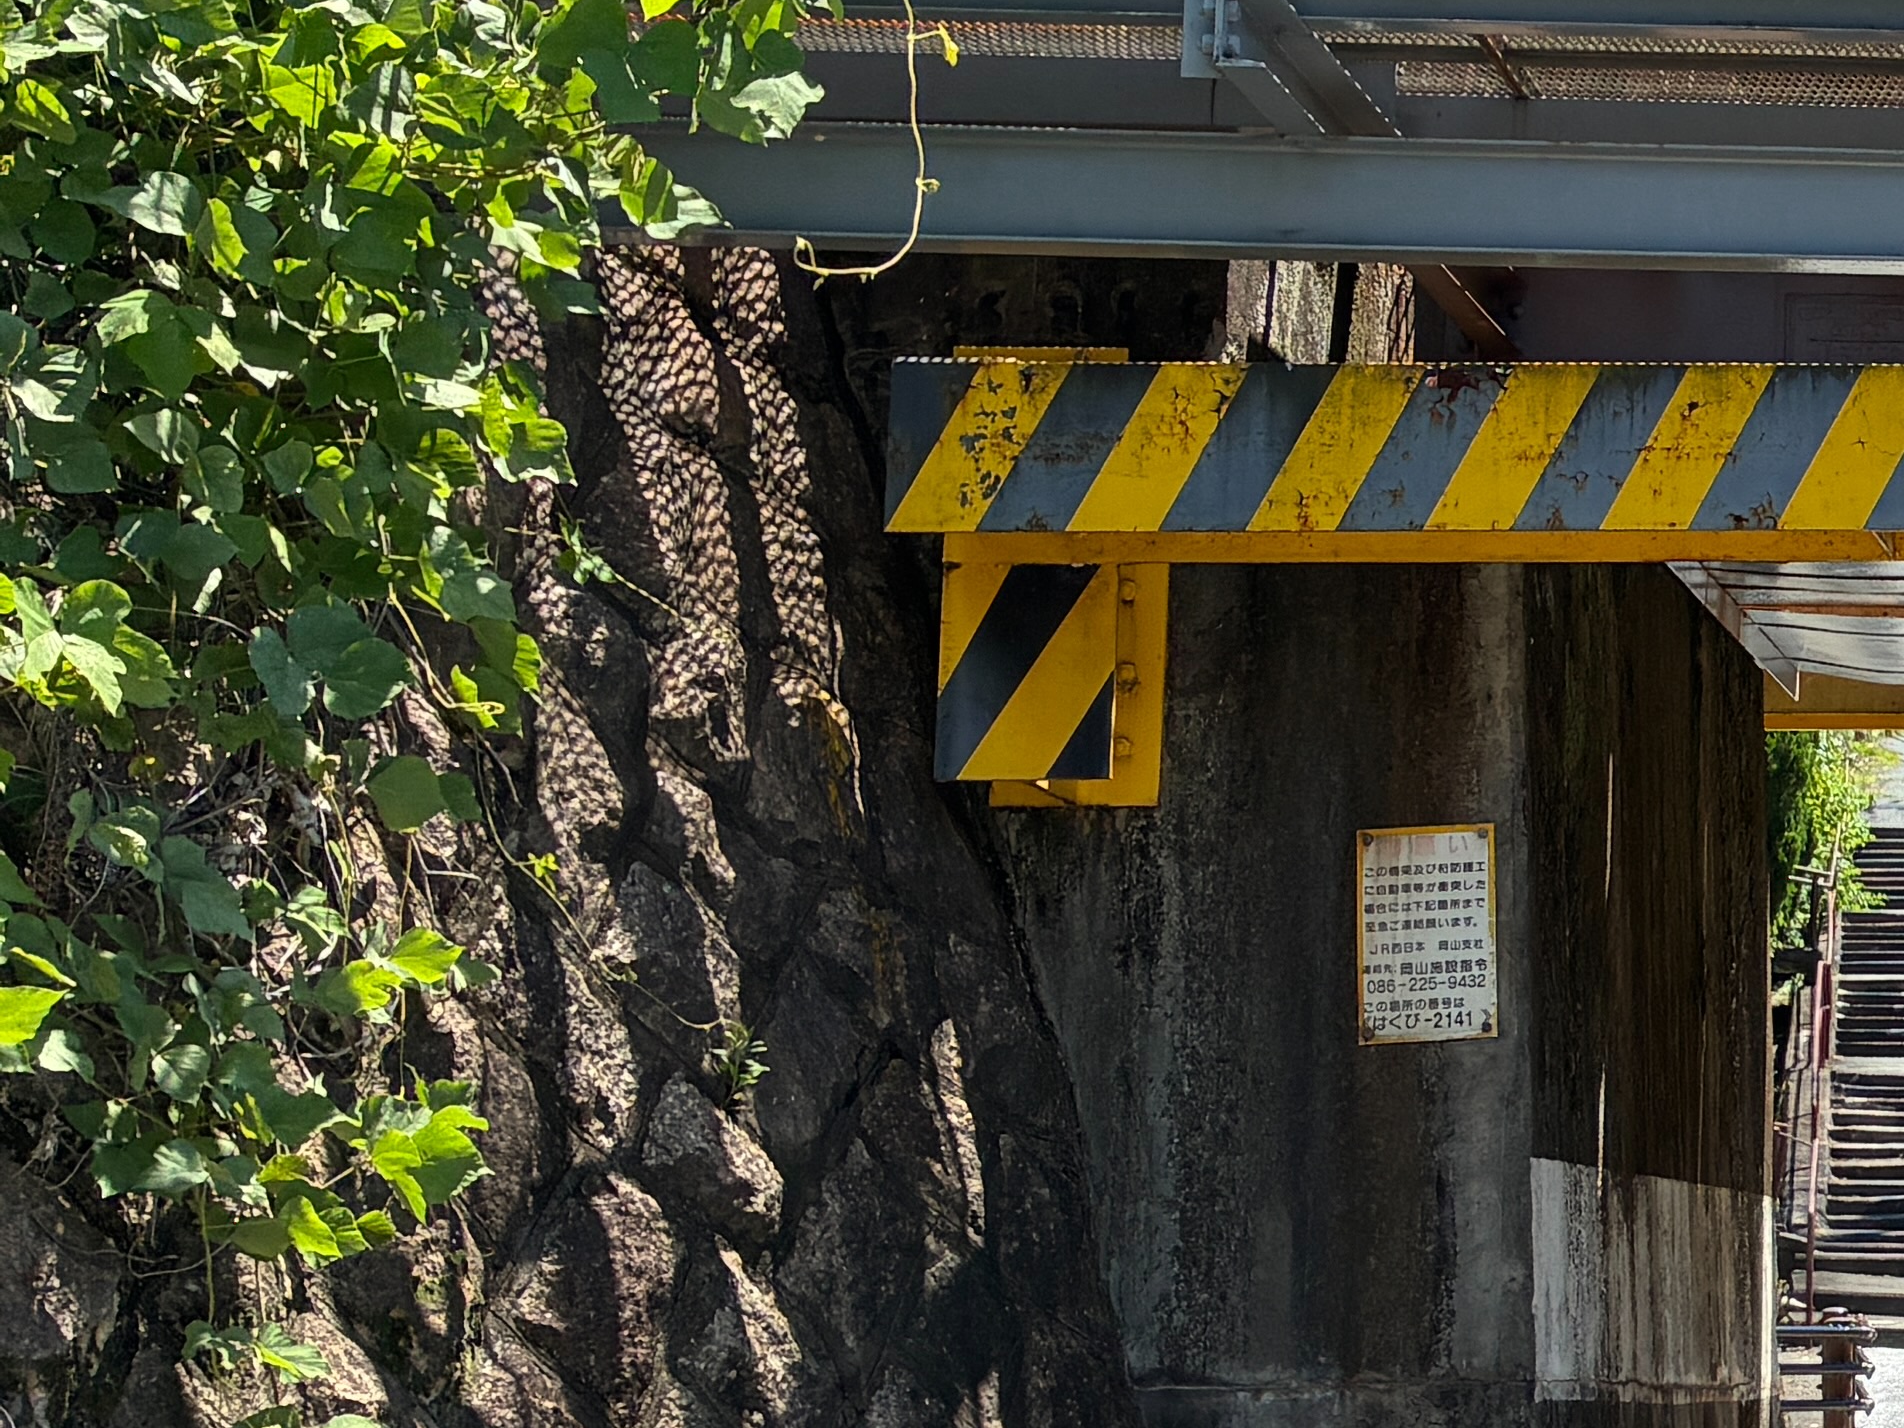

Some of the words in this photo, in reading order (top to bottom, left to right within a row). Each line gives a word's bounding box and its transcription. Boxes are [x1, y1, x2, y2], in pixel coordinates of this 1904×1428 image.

[1364, 879, 1486, 896] に自動車等が衝突した
[1369, 941, 1426, 955] JR西日本
[1438, 939, 1484, 951] 岡山支社
[1367, 973, 1486, 994] 086-225-9432
